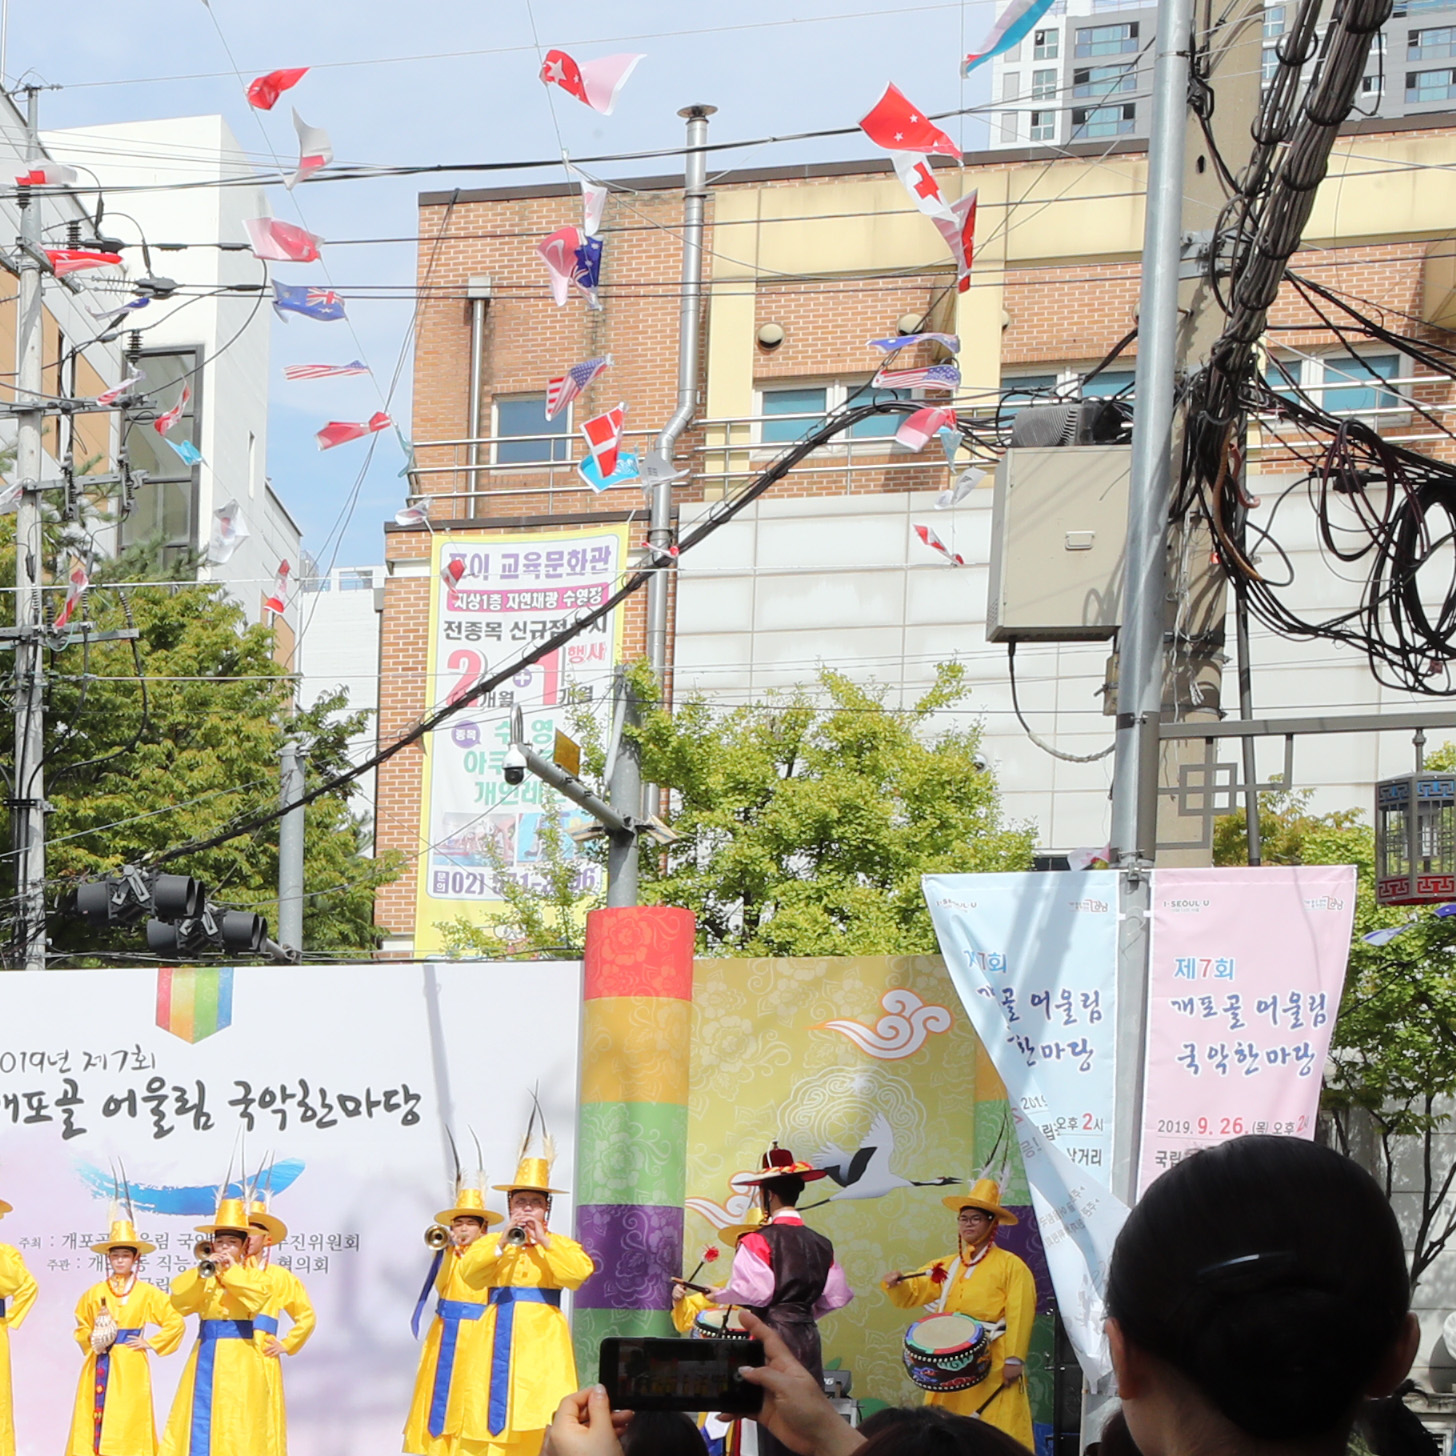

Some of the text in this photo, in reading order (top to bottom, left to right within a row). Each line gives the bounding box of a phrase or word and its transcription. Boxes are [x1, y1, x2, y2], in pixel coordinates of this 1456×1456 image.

[500, 545, 611, 580] 교육문화관
[454, 586, 602, 611] 지상1층 자연채광 수영장
[443, 620, 503, 641] 전종목
[568, 642, 606, 663] 행사
[1174, 957, 1235, 980] 제7회
[1030, 988, 1102, 1026] 어울림
[1170, 991, 1327, 1030] 개포골 어울림
[82, 1043, 157, 1072] 제7회
[1177, 1041, 1316, 1076] 국악한마당
[102, 1075, 215, 1140] 어울림
[227, 1077, 421, 1132] 국악한마당
[1056, 1117, 1078, 1131] 오후
[1158, 1119, 1193, 1135] 2019.
[1197, 1117, 1214, 1135] 9.
[1251, 1121, 1269, 1135] (목)
[1272, 1121, 1295, 1135] 오후
[18, 1236, 42, 1250] 주최
